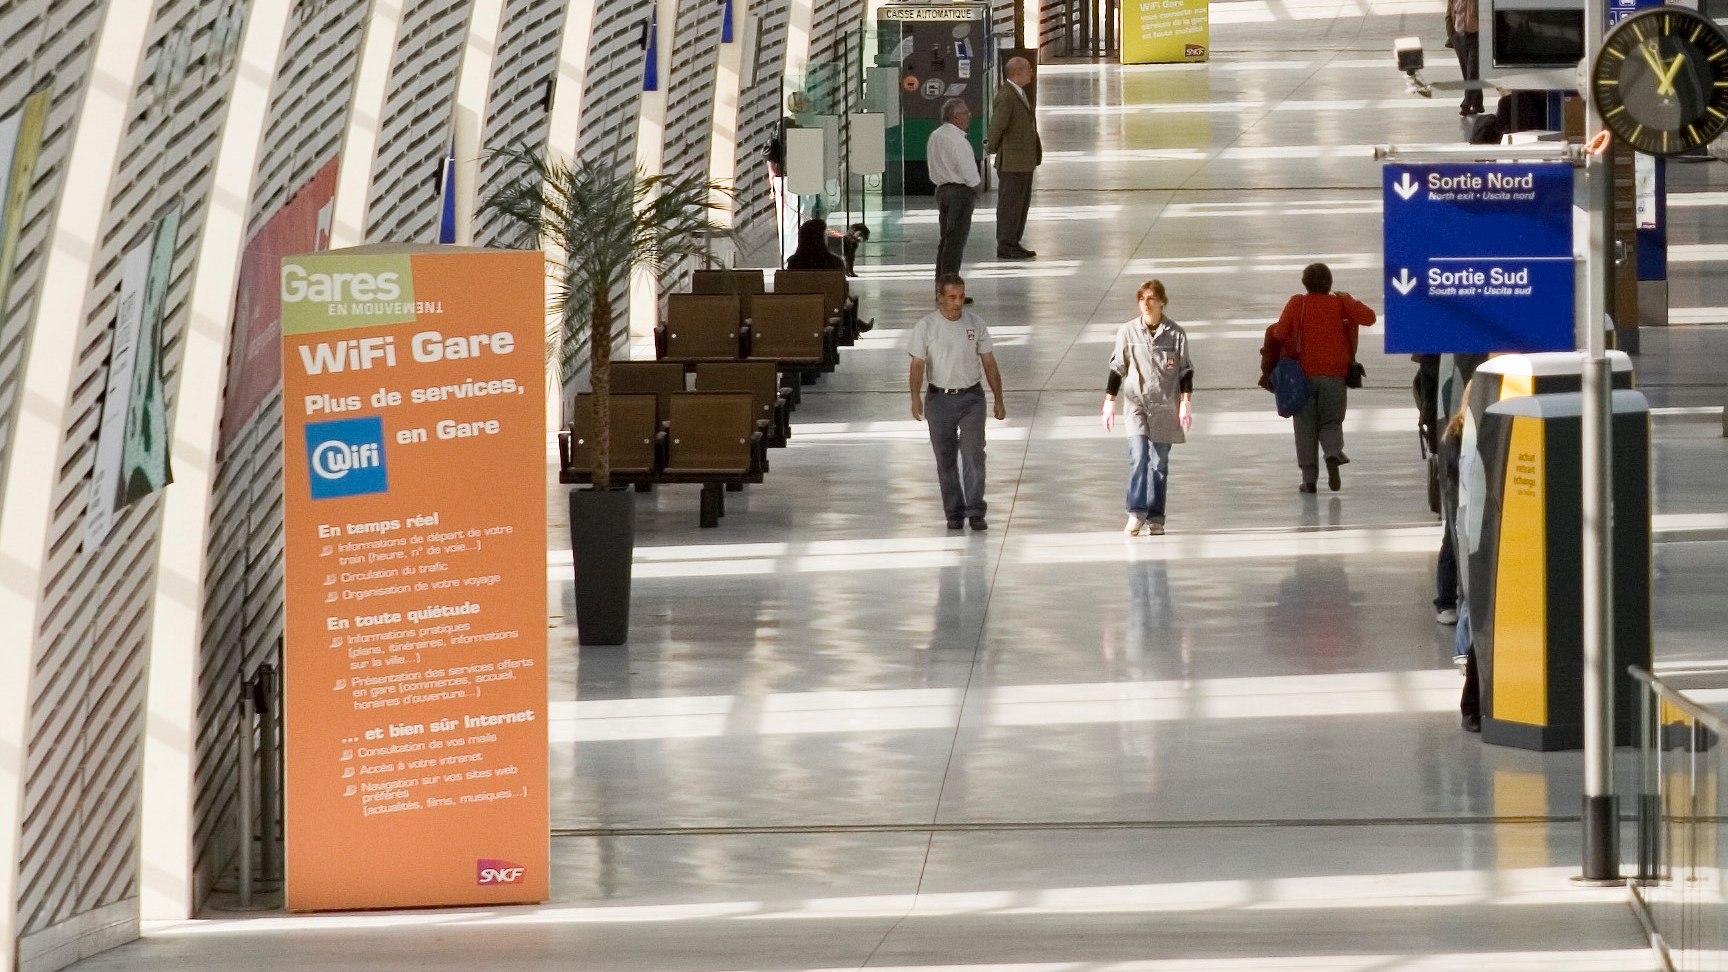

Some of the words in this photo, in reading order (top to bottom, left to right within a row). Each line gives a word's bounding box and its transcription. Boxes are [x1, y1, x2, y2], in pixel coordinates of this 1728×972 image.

[886, 9, 914, 19] CAISSE
[916, 9, 971, 19] AUTOMATIQUE
[1428, 173, 1482, 189] Sortie
[1488, 172, 1533, 188] Nord
[1428, 191, 1455, 200] North
[1457, 191, 1474, 200] exit
[1482, 191, 1511, 200] Uscita
[1513, 191, 1535, 200] nord
[282, 264, 400, 303] Gares
[1428, 268, 1485, 285] Sortie
[1490, 268, 1528, 285] Sud
[1428, 286, 1456, 295] South
[1458, 286, 1476, 295] exit
[1483, 286, 1512, 295] Uscita
[1514, 286, 1532, 295] sud
[328, 303, 347, 316] EN
[298, 335, 397, 375] WiFi
[411, 330, 515, 364] Gare
[304, 392, 362, 415] Plus
[371, 388, 402, 408] de
[411, 377, 524, 403] services,
[395, 427, 427, 445] en
[435, 418, 501, 441] Gare
[318, 524, 341, 539] En
[346, 519, 401, 534] temps
[406, 511, 439, 528] réel
[337, 537, 407, 552] Informations
[410, 534, 424, 544] de
[426, 531, 465, 543] départ
[467, 528, 481, 537] de
[483, 525, 513, 536] votre
[339, 554, 365, 565] train
[426, 546, 440, 555] de
[340, 569, 399, 583] Circulation
[401, 566, 416, 575] du
[419, 562, 448, 574] trafic
[342, 584, 411, 601] Organisation
[414, 581, 429, 592] de
[431, 579, 460, 589] votre
[462, 574, 501, 587] voyage
[326, 616, 350, 631] En
[354, 612, 402, 627] toute
[407, 601, 480, 624] quiétude
[347, 629, 416, 644] Informations
[419, 623, 471, 638] pratiques
[450, 630, 519, 644] informations
[350, 660, 369, 670] sur
[372, 658, 382, 667] la
[352, 671, 421, 686] Présentation
[424, 669, 446, 678] des
[448, 663, 494, 675] services
[496, 659, 534, 670] offerts
[352, 689, 367, 698] en
[370, 685, 396, 698] gare
[353, 697, 401, 710] horaires
[365, 727, 385, 740] et
[389, 722, 424, 738] bien
[429, 718, 459, 732] sûr
[464, 709, 535, 729] Internet
[357, 742, 426, 758] Consultation
[428, 740, 443, 749] de
[445, 738, 465, 747] vos
[468, 733, 497, 744] mails
[360, 763, 394, 775] Accès
[408, 758, 437, 769] votre
[440, 752, 484, 765] intranet
[361, 778, 419, 792] Navigation
[421, 775, 441, 786] sur
[443, 773, 463, 782] vos
[465, 769, 493, 780] sites
[494, 765, 519, 776] web
[362, 789, 410, 804] préférés
[479, 867, 525, 883] SNCF
